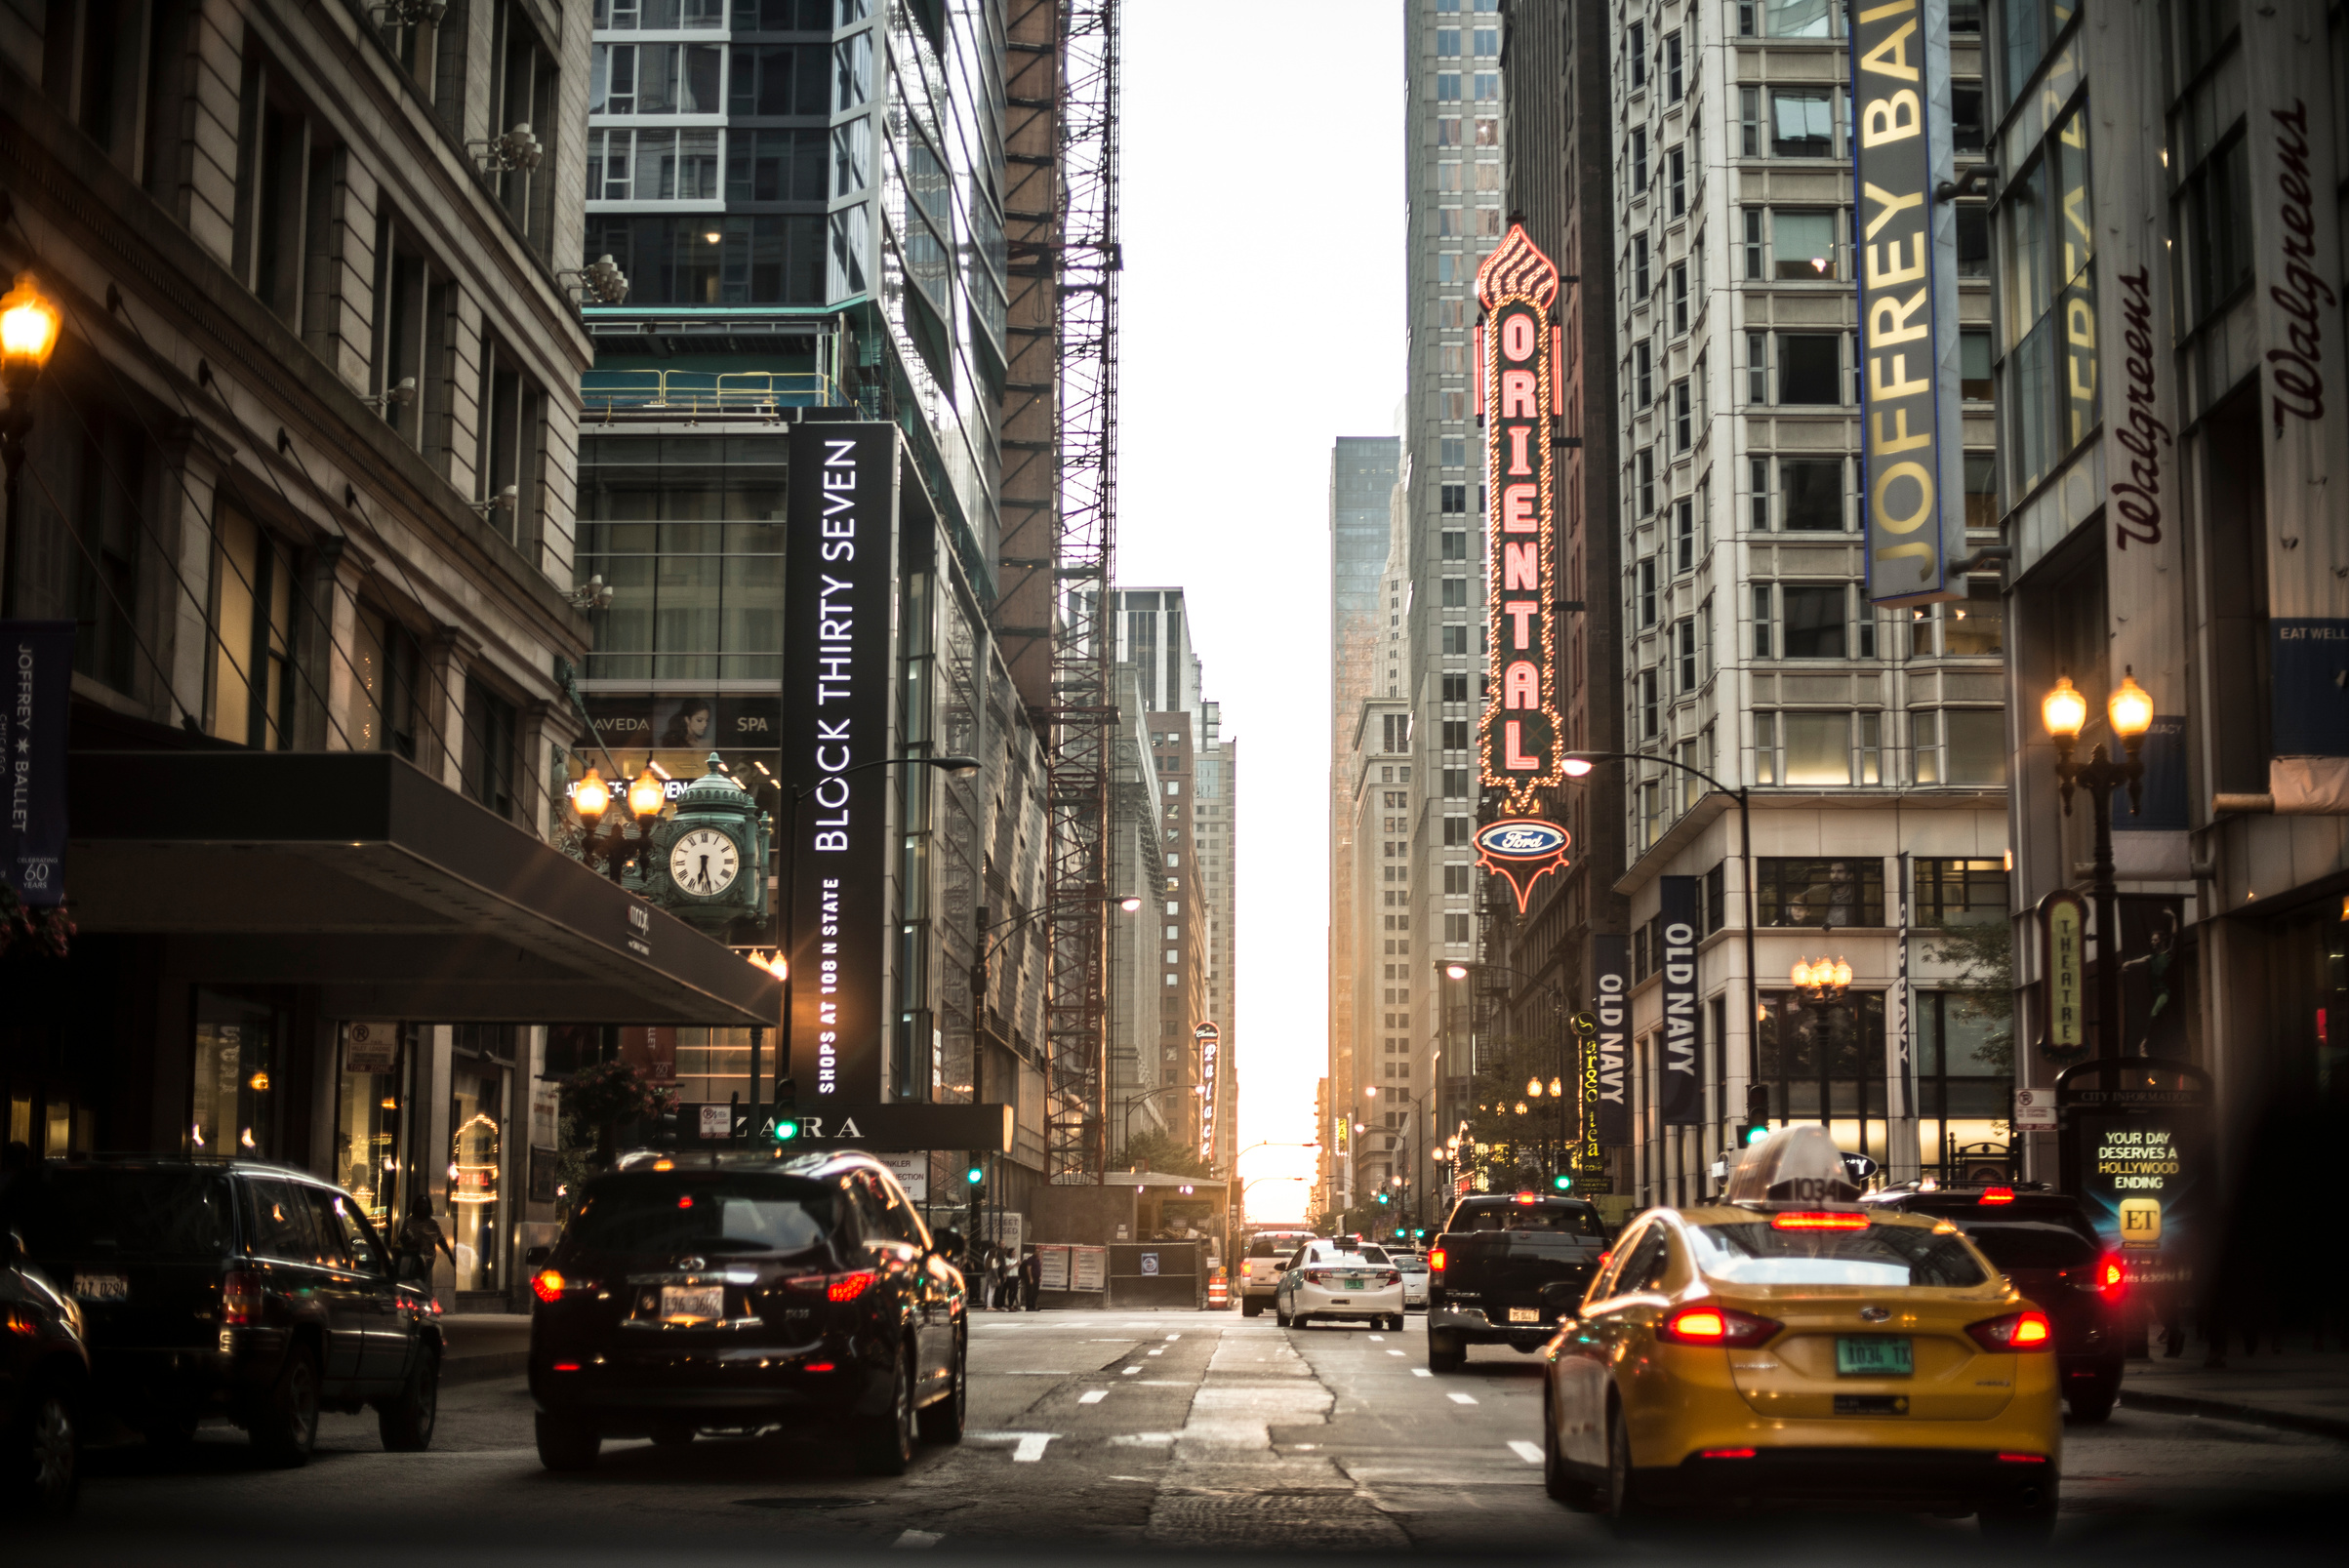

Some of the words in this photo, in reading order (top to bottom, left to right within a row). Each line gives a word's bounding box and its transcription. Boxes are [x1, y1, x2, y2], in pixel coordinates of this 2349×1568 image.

[2266, 98, 2336, 427] Walgreens
[1864, 181, 1932, 583] JOFFREY
[2111, 263, 2172, 551] Walgreens
[821, 441, 857, 561] SEVEN
[1501, 312, 1540, 771] ORIENTAL
[818, 574, 853, 705] THIRTY
[2280, 626, 2308, 640] EAT
[17, 643, 33, 730] JOFFREY
[593, 718, 650, 731] AVEDA
[737, 716, 769, 732] SPA
[12, 760, 29, 832] BALLET
[815, 718, 851, 852] BLOCK
[1502, 829, 1544, 849] Ford
[24, 863, 49, 882] 60
[822, 878, 839, 936] STATE
[822, 943, 837, 954] N
[1665, 922, 1694, 985] OLD
[821, 959, 837, 994] 108
[1599, 973, 1624, 1026] OLD
[2060, 919, 2072, 1039] THEATRE
[647, 1026, 657, 1050] LLET
[820, 1001, 836, 1025] AT
[1666, 992, 1695, 1077] NAVY
[1899, 976, 1909, 1065] NAVY
[819, 1030, 836, 1094] SHOPS
[1584, 1040, 1598, 1103] argo
[1600, 1032, 1625, 1105] NAVY
[1201, 1043, 1217, 1156] Palace
[2080, 1091, 2110, 1102] CITY
[2113, 1091, 2191, 1102] INFORMATION
[737, 1116, 866, 1138] ZARA
[2098, 1146, 2167, 1159] DESERVES
[2167, 1146, 2178, 1159] A
[2105, 1131, 2143, 1145] YOUR
[2145, 1131, 2171, 1145] DAY
[1795, 1177, 1838, 1202] 1034
[2098, 1161, 2180, 1175] HOLLYWOOD
[2114, 1176, 2165, 1189] ENDING
[2125, 1210, 2158, 1230] ET
[1892, 1346, 1911, 1365] TX
